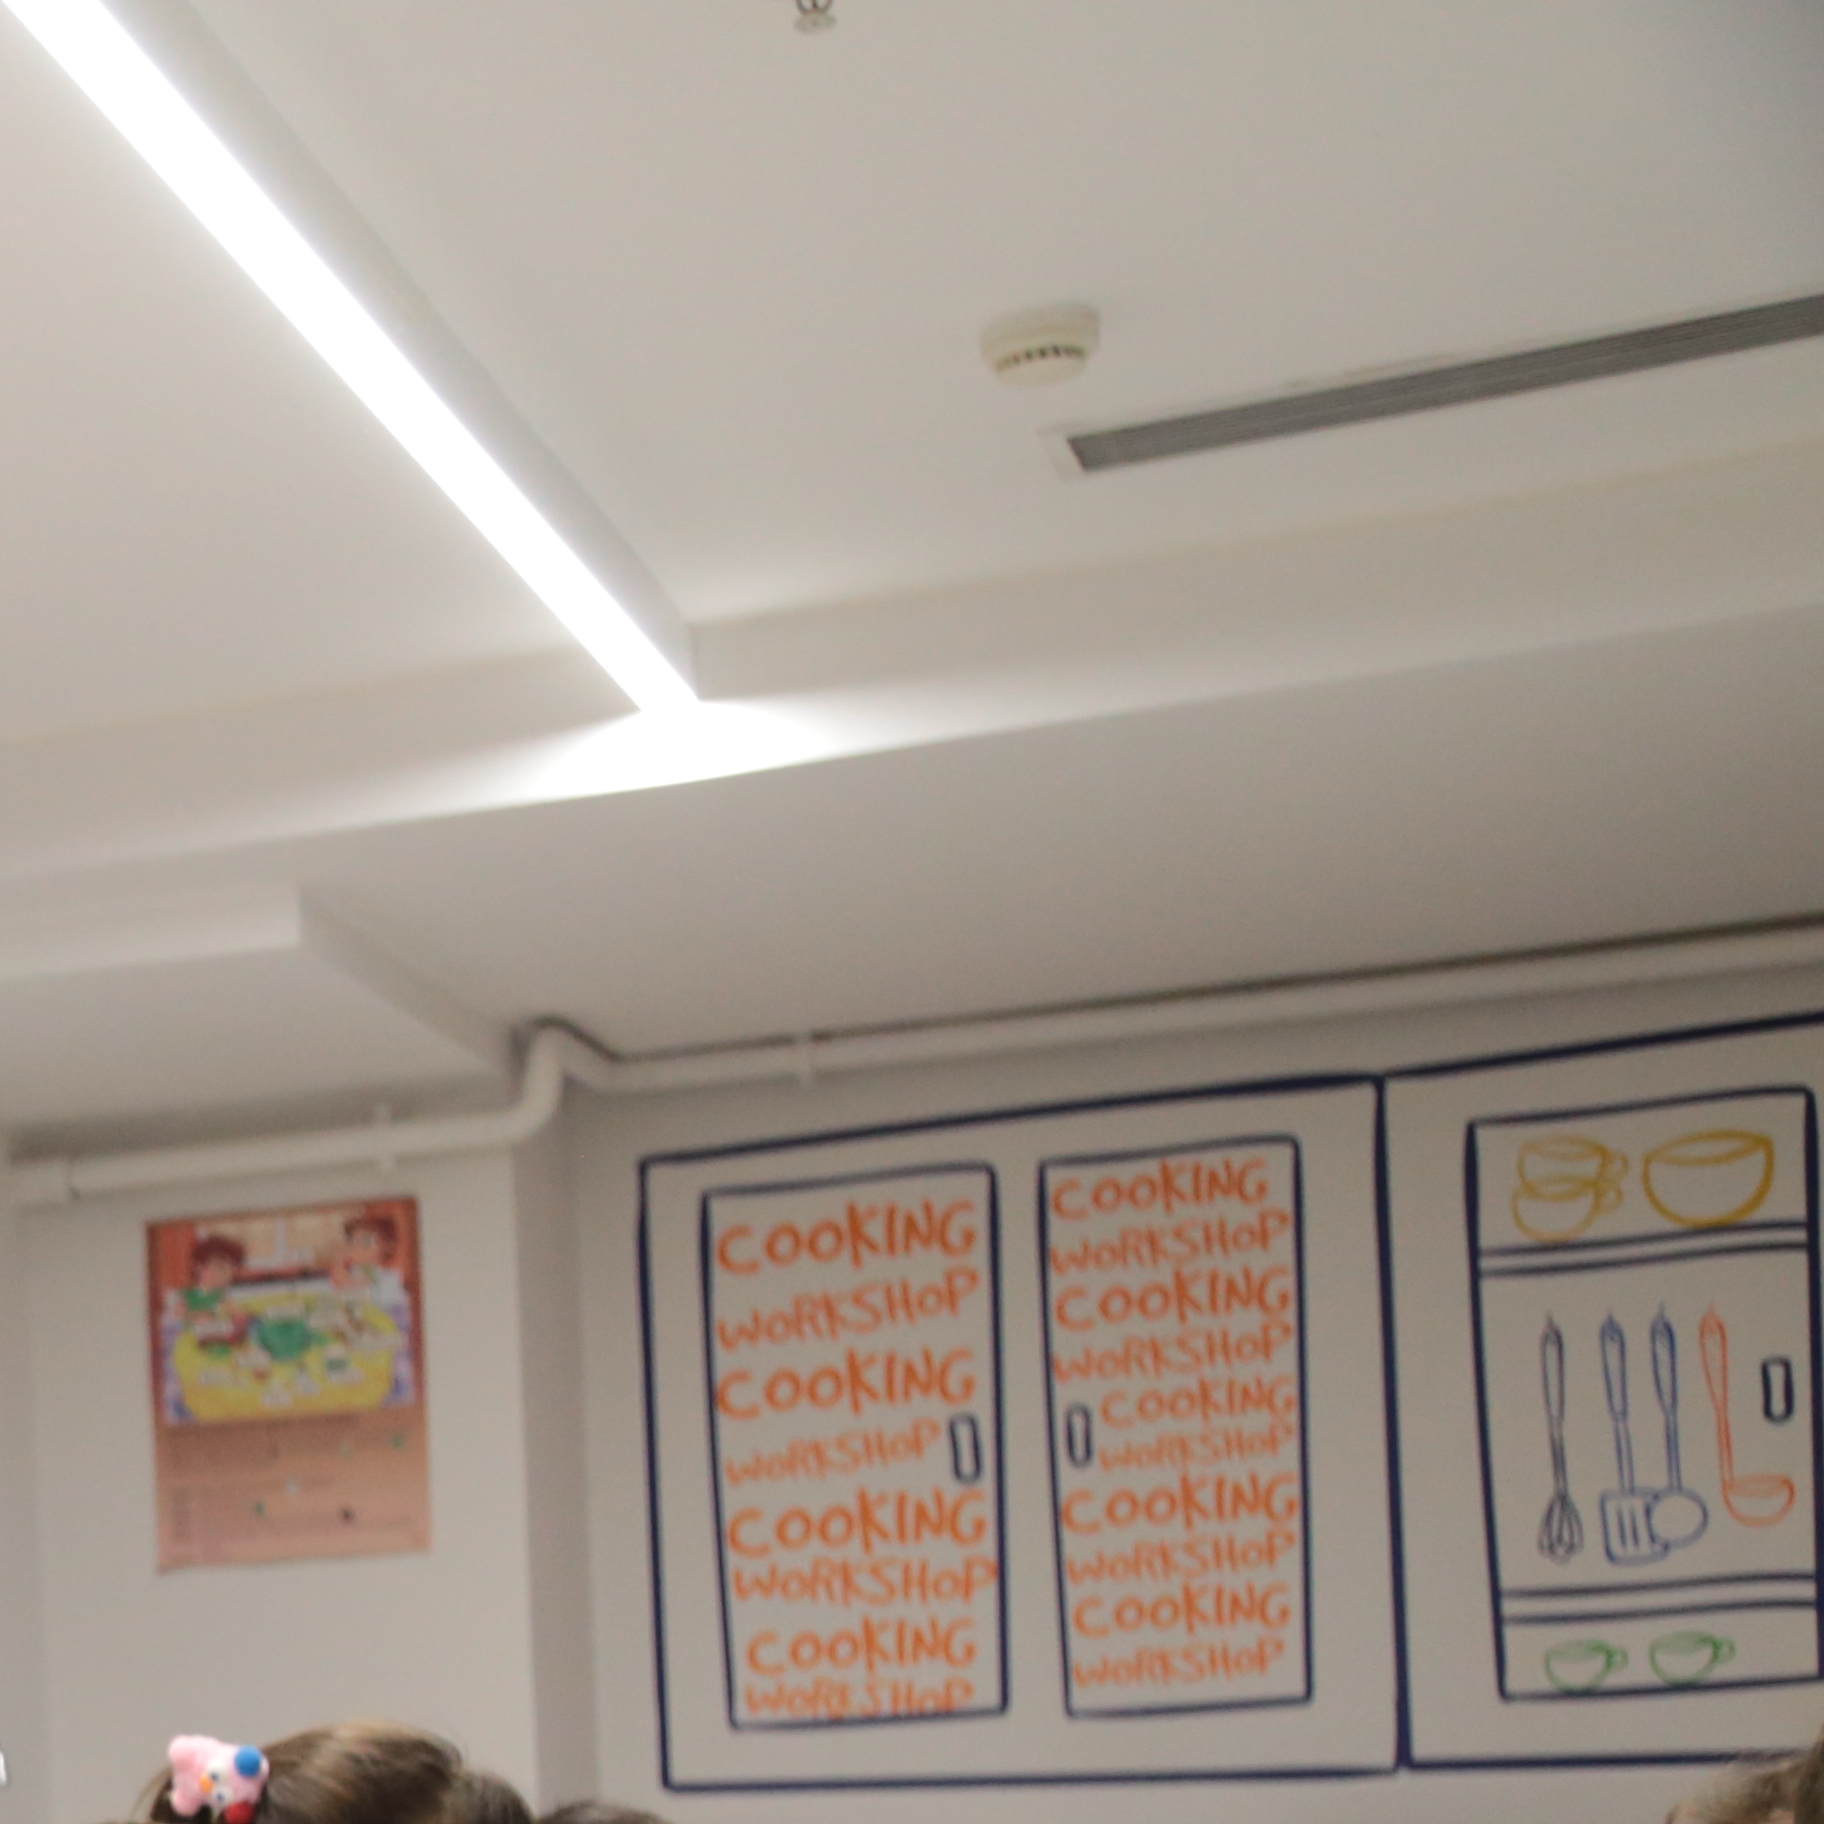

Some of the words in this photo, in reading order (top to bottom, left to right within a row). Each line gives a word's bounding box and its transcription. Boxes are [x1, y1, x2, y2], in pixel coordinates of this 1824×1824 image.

[1052, 1157, 1269, 1221] COOKING
[716, 1199, 976, 1274] COOKING
[1050, 1208, 1289, 1274] WORKSHOP
[716, 1266, 978, 1351] WORKSHOP
[1056, 1264, 1290, 1333] COOKING
[715, 1347, 976, 1420] COOKING
[1052, 1321, 1292, 1385] WORKSHOP
[1102, 1375, 1295, 1429] COOKING
[725, 1417, 942, 1486] WORKSHOP
[727, 1487, 987, 1559] COOKING
[1062, 1472, 1297, 1534] COOKING
[732, 1555, 998, 1607] WORKSHOP
[1067, 1528, 1295, 1584] WORKSHOP
[1072, 1581, 1291, 1638] COOKING
[746, 1616, 978, 1676] COOKING
[1073, 1636, 1284, 1688] WORKSHOP
